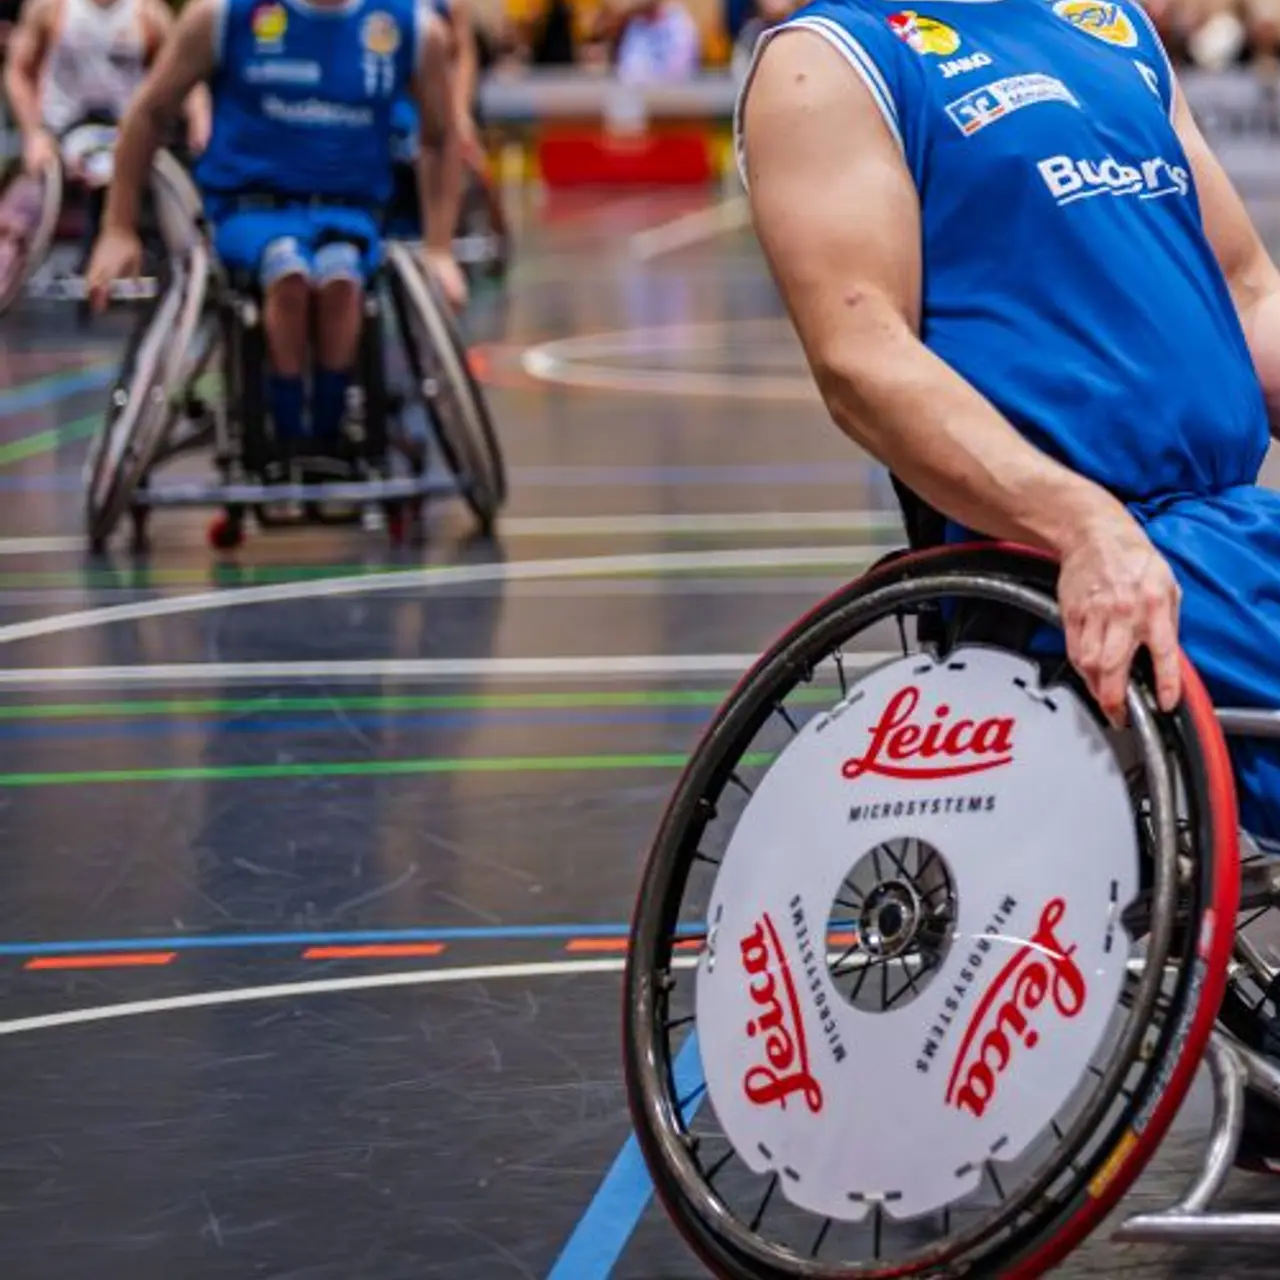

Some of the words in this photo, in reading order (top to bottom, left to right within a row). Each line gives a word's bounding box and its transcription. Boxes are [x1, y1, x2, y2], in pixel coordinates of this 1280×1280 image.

[842, 686, 1016, 780] Leica
[849, 795, 996, 822] MICROSYSTEMS
[741, 912, 823, 1114] Leica
[790, 894, 847, 1063] MICROSYSTEMS
[915, 895, 1018, 1074] MICROSYSTEMS
[945, 898, 1086, 1118] Leica
